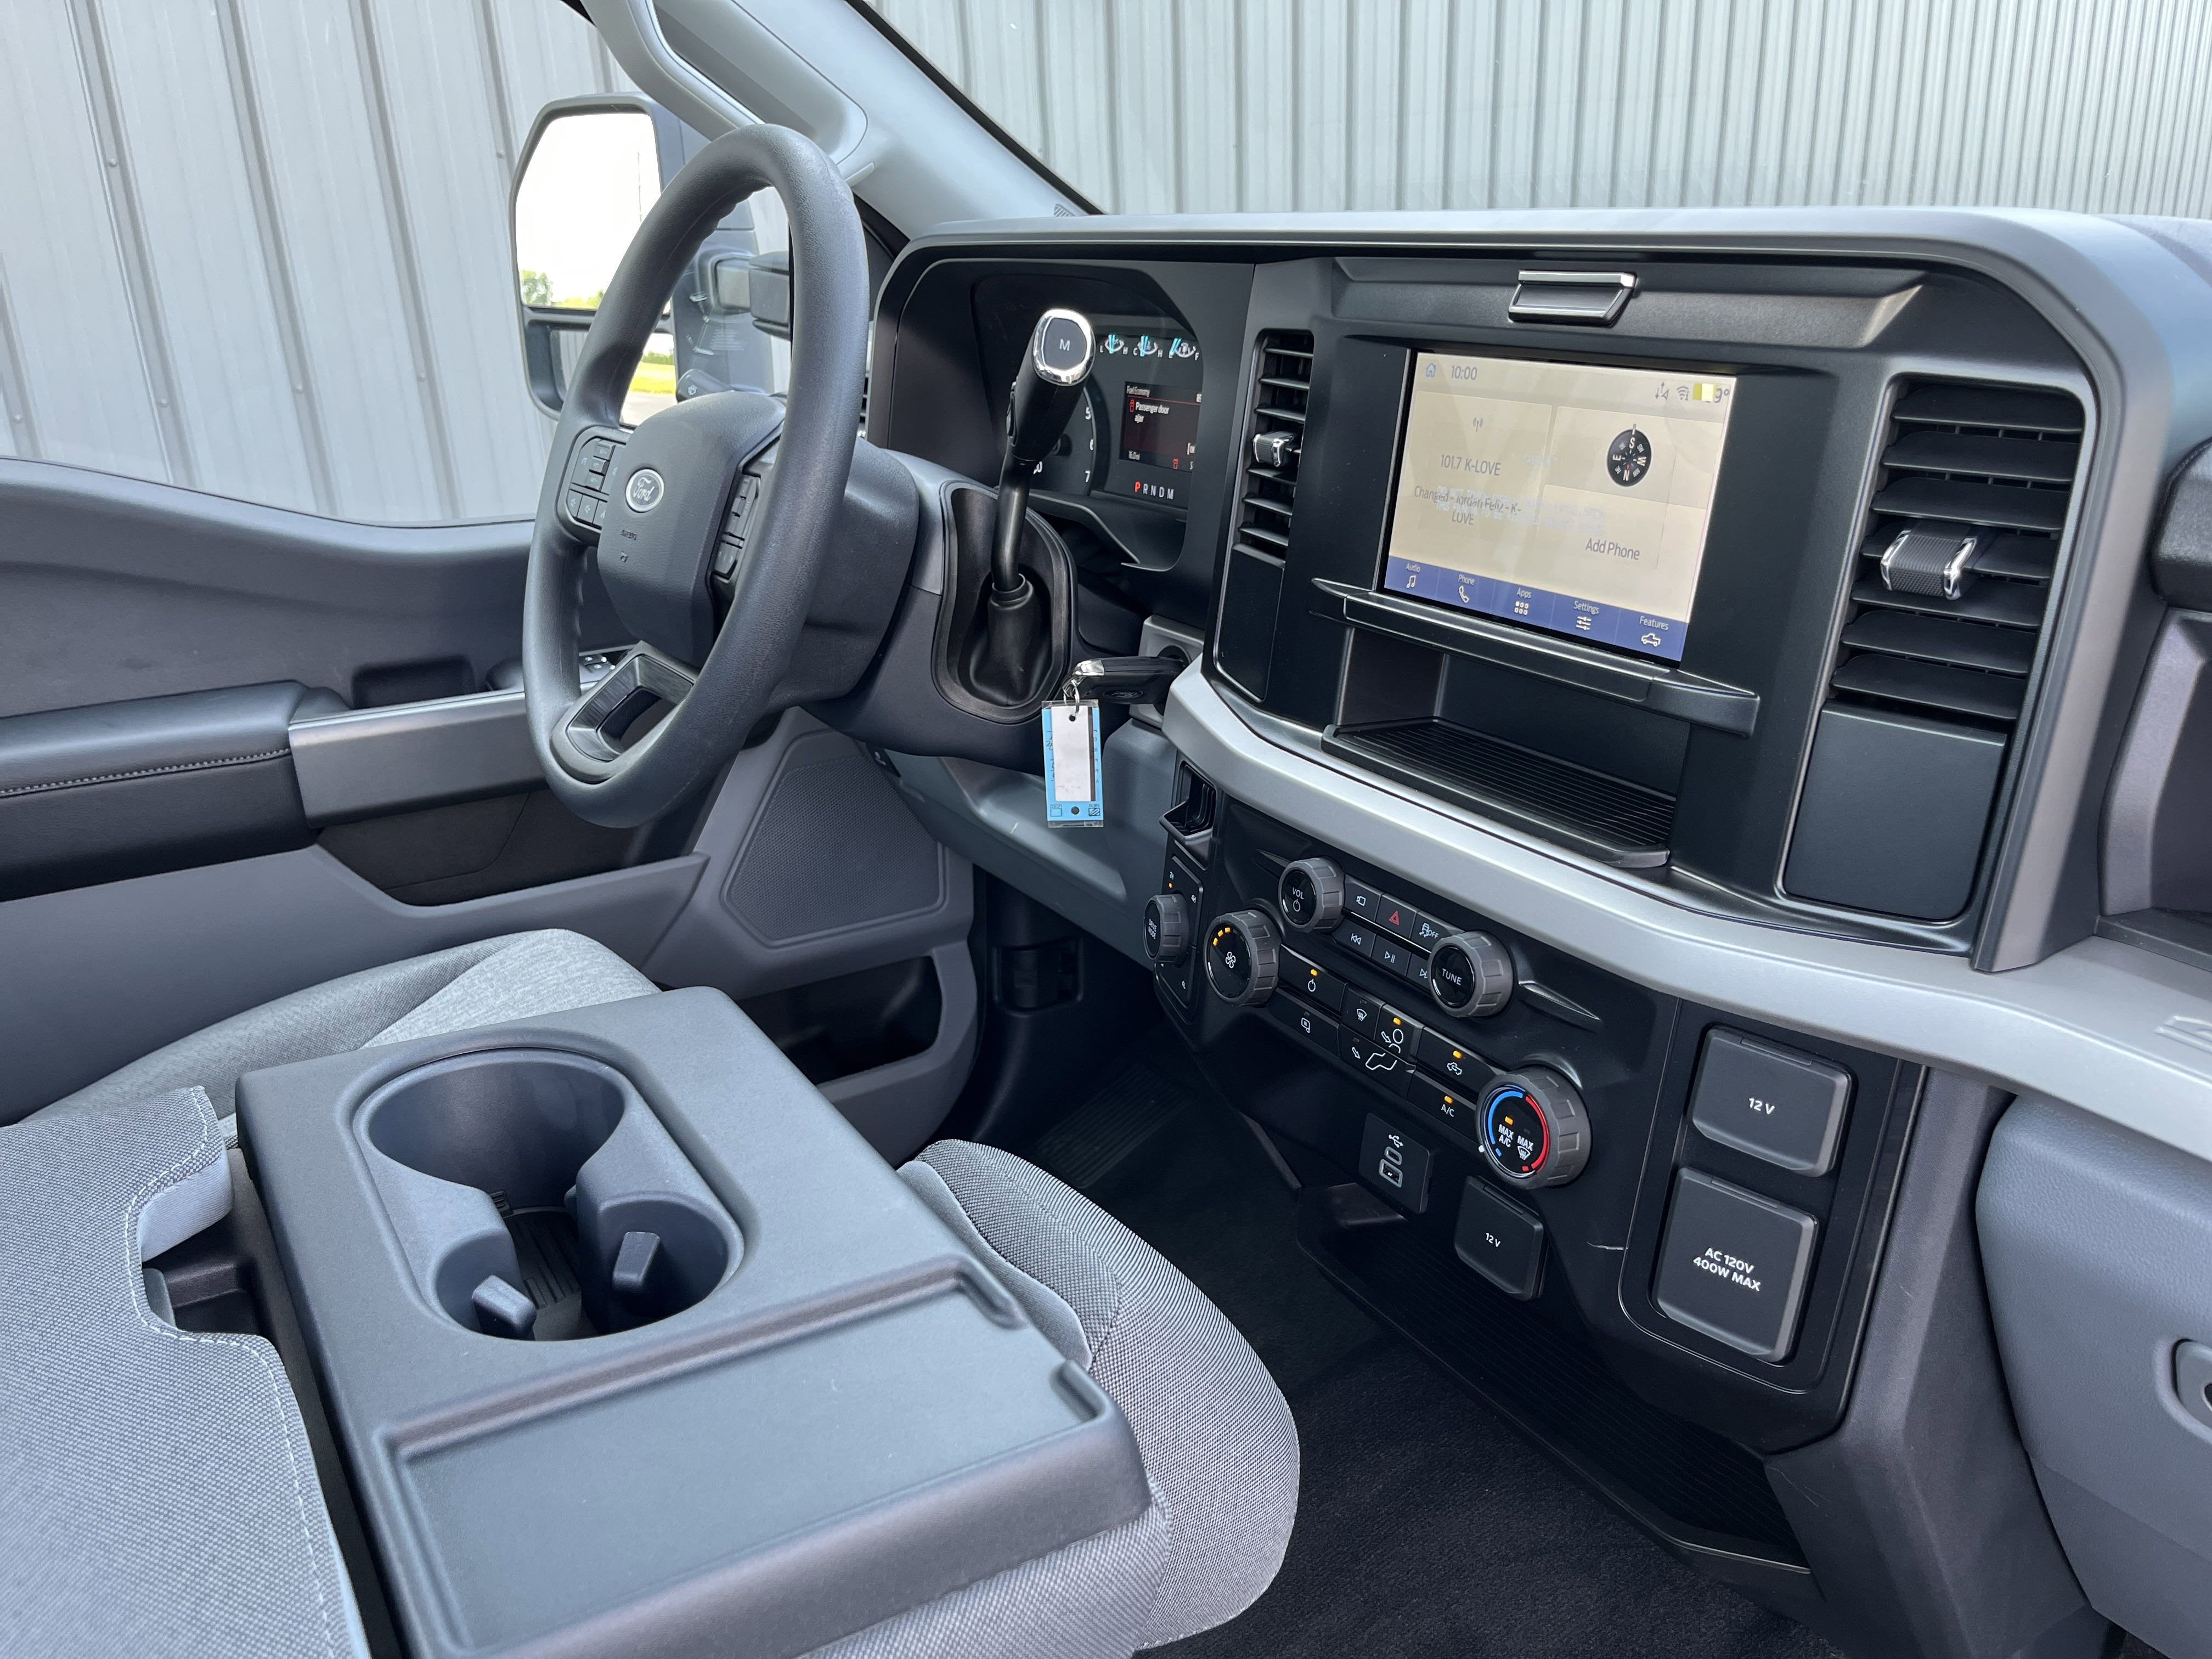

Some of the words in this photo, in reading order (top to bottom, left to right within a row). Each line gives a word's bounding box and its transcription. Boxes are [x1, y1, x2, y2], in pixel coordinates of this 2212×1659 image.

[1059, 338, 1070, 351] M
[1158, 349, 1164, 358] H
[1451, 365, 1478, 380] 10:00
[1085, 407, 1091, 420] 5
[1135, 402, 1158, 414] Passenger
[1158, 404, 1170, 415] door
[1629, 437, 1635, 449] S
[1441, 454, 1462, 470] 101.7
[1464, 458, 1502, 476] K-LOVE
[1637, 456, 1647, 466] W
[1085, 470, 1091, 483] 7
[1623, 470, 1630, 481] N
[633, 477, 655, 501] Ford
[1135, 481, 1141, 493] P
[1143, 483, 1148, 495] R
[1150, 485, 1156, 496] N
[1159, 487, 1165, 498] D
[1167, 488, 1174, 500] M
[1414, 486, 1449, 504] Changed
[1452, 510, 1474, 526] LOVE
[1585, 538, 1606, 554] Add
[1607, 541, 1640, 561] Phone
[1406, 562, 1421, 573] Audio
[1458, 574, 1475, 585] Phone
[1516, 588, 1531, 599] Apps
[1573, 601, 1600, 615] Settings
[1639, 616, 1669, 630] Features
[1293, 887, 1304, 900] VOL
[1427, 929, 1439, 939] OFF
[1442, 968, 1462, 986] TUNE
[1441, 1104, 1454, 1118] A/C
[1748, 1098, 1763, 1111] 12
[1765, 1103, 1775, 1114] V
[1498, 1124, 1514, 1140] MAX
[1499, 1134, 1511, 1148] A/C
[1517, 1135, 1534, 1152] MAX
[1486, 1233, 1494, 1244] 12
[1495, 1238, 1501, 1248] V
[1705, 1248, 1723, 1262] AC
[1724, 1255, 1754, 1274] 120V
[1693, 1256, 1730, 1278] 400W
[1731, 1272, 1761, 1291] MAX
